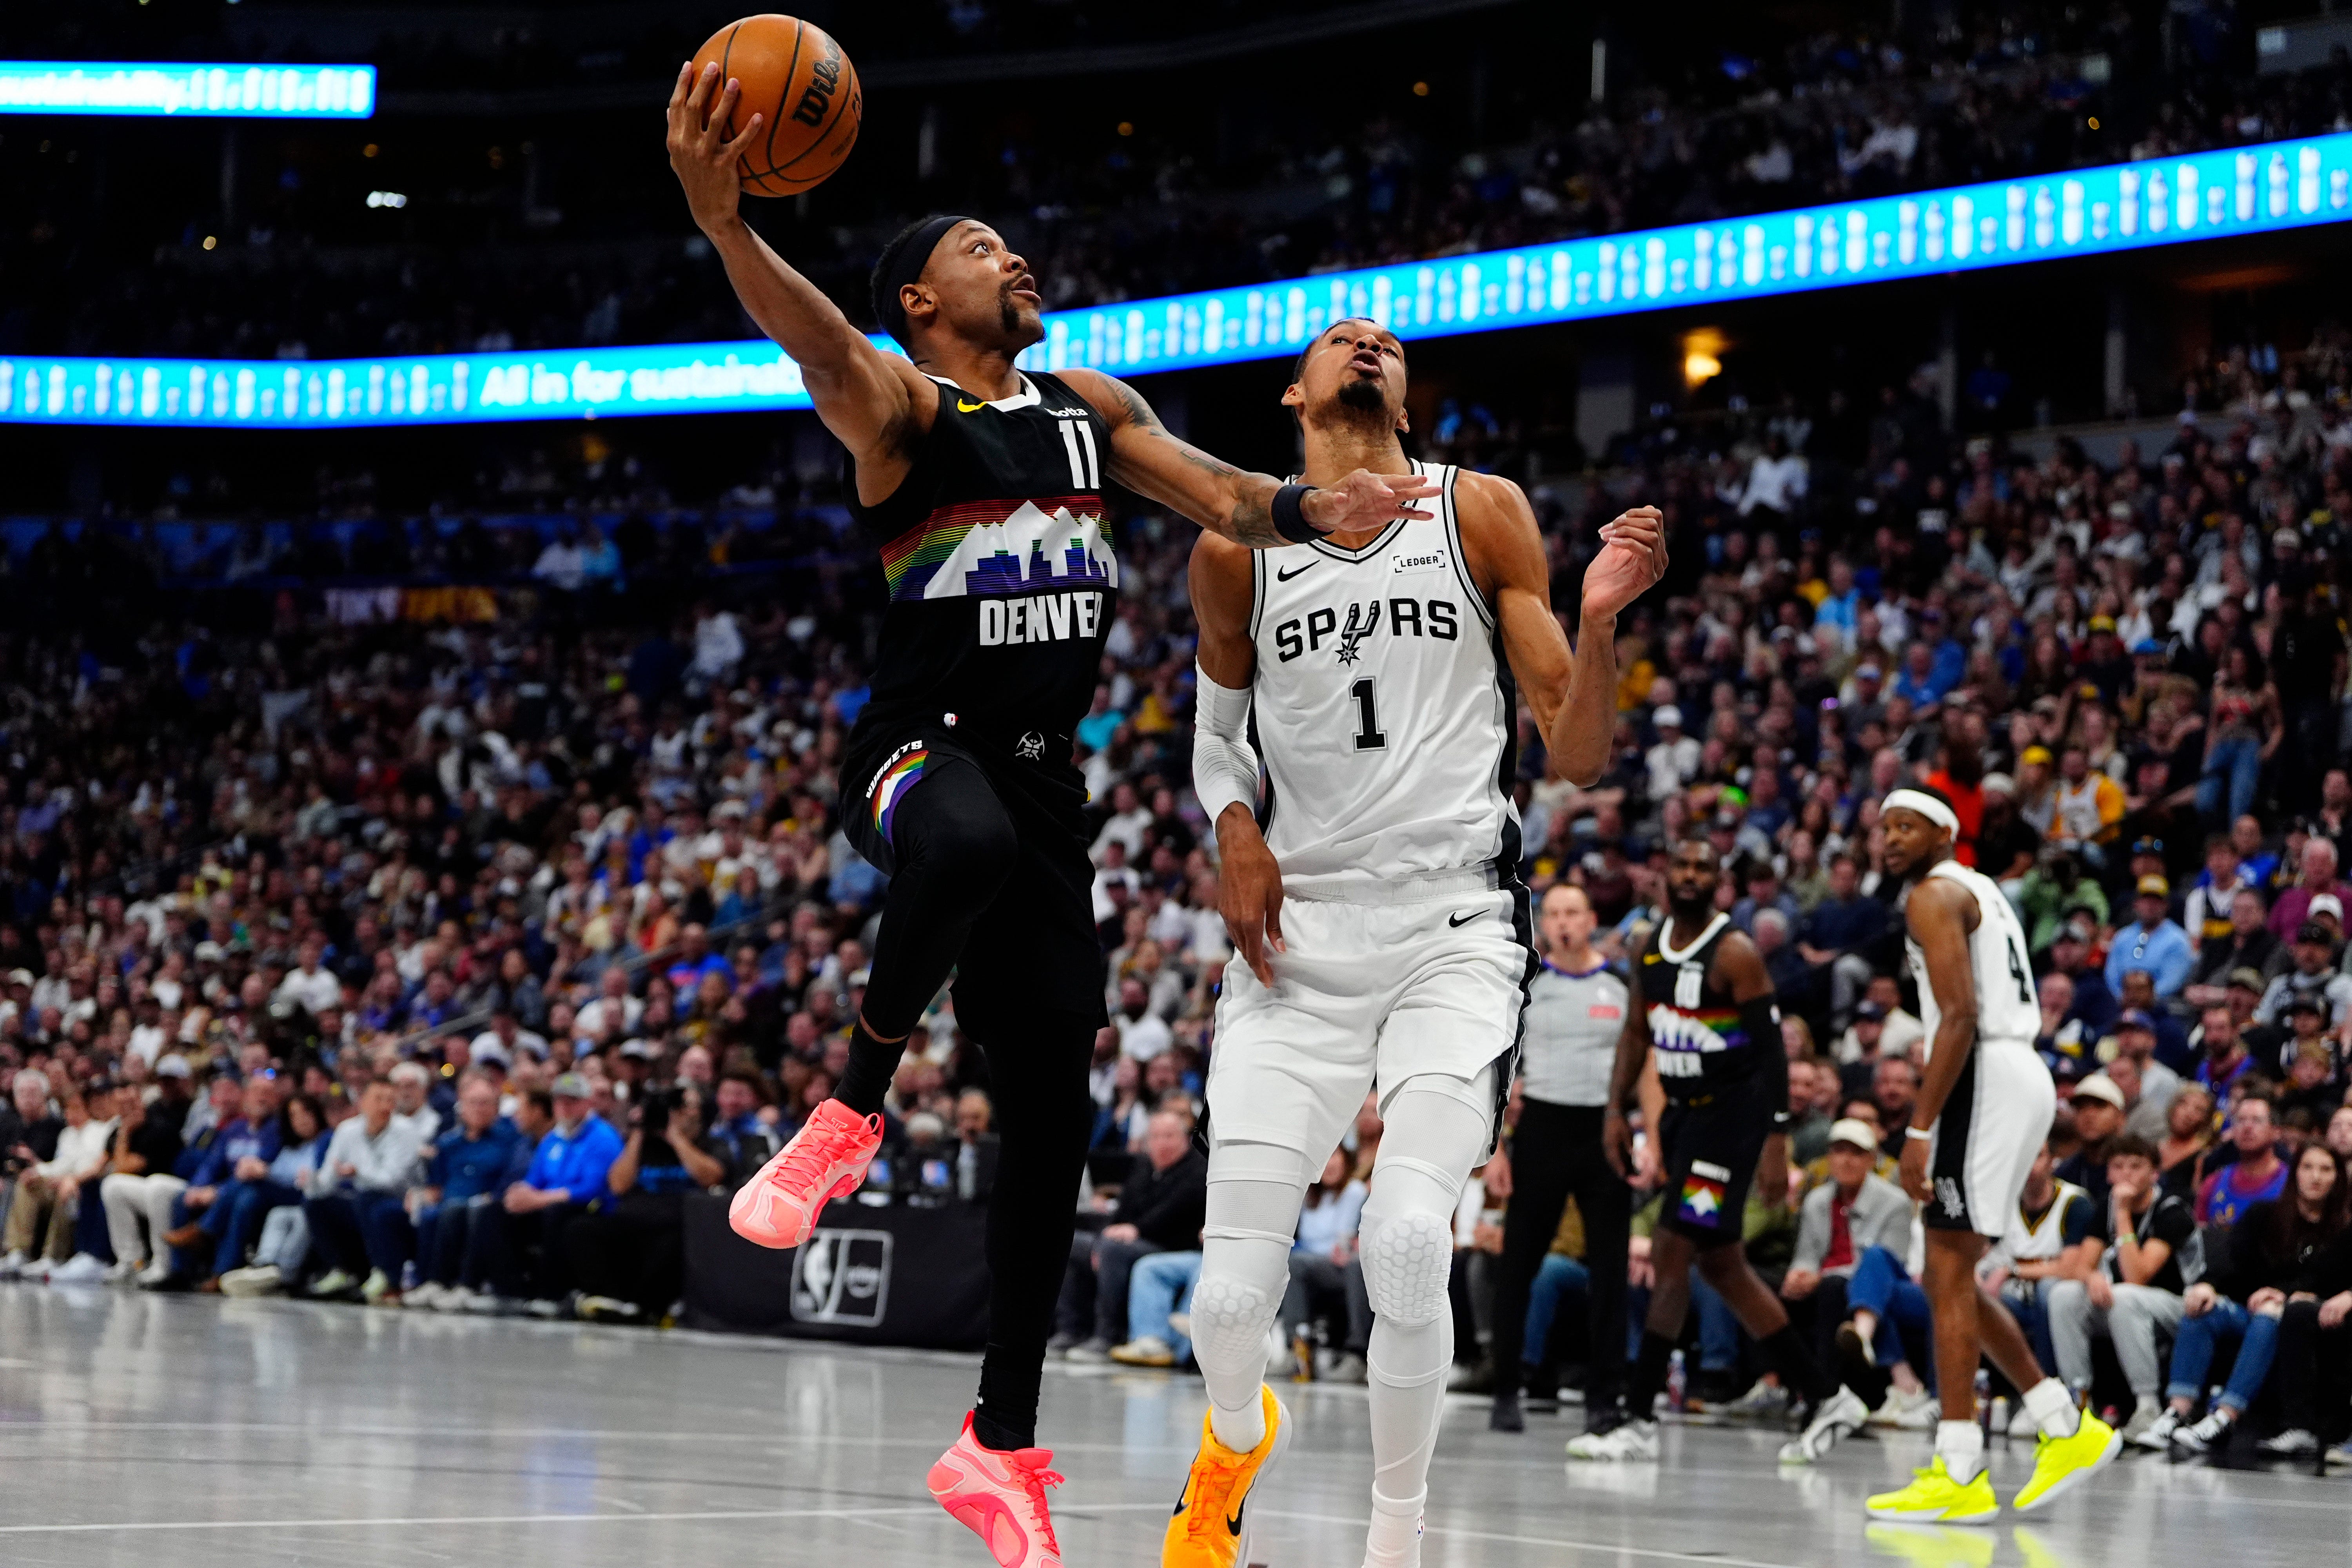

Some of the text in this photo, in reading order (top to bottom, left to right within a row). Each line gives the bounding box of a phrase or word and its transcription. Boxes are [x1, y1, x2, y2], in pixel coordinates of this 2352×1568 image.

[479, 352, 808, 407] All in for sustainab
[1058, 420, 1099, 489] 11
[1400, 556, 1438, 567] LEDGER
[1275, 600, 1458, 668] SPURS
[1349, 676, 1389, 753] 1
[866, 740, 923, 799] NUGGETS
[1674, 968, 1703, 1010] 10
[2007, 935, 2031, 1002] 4
